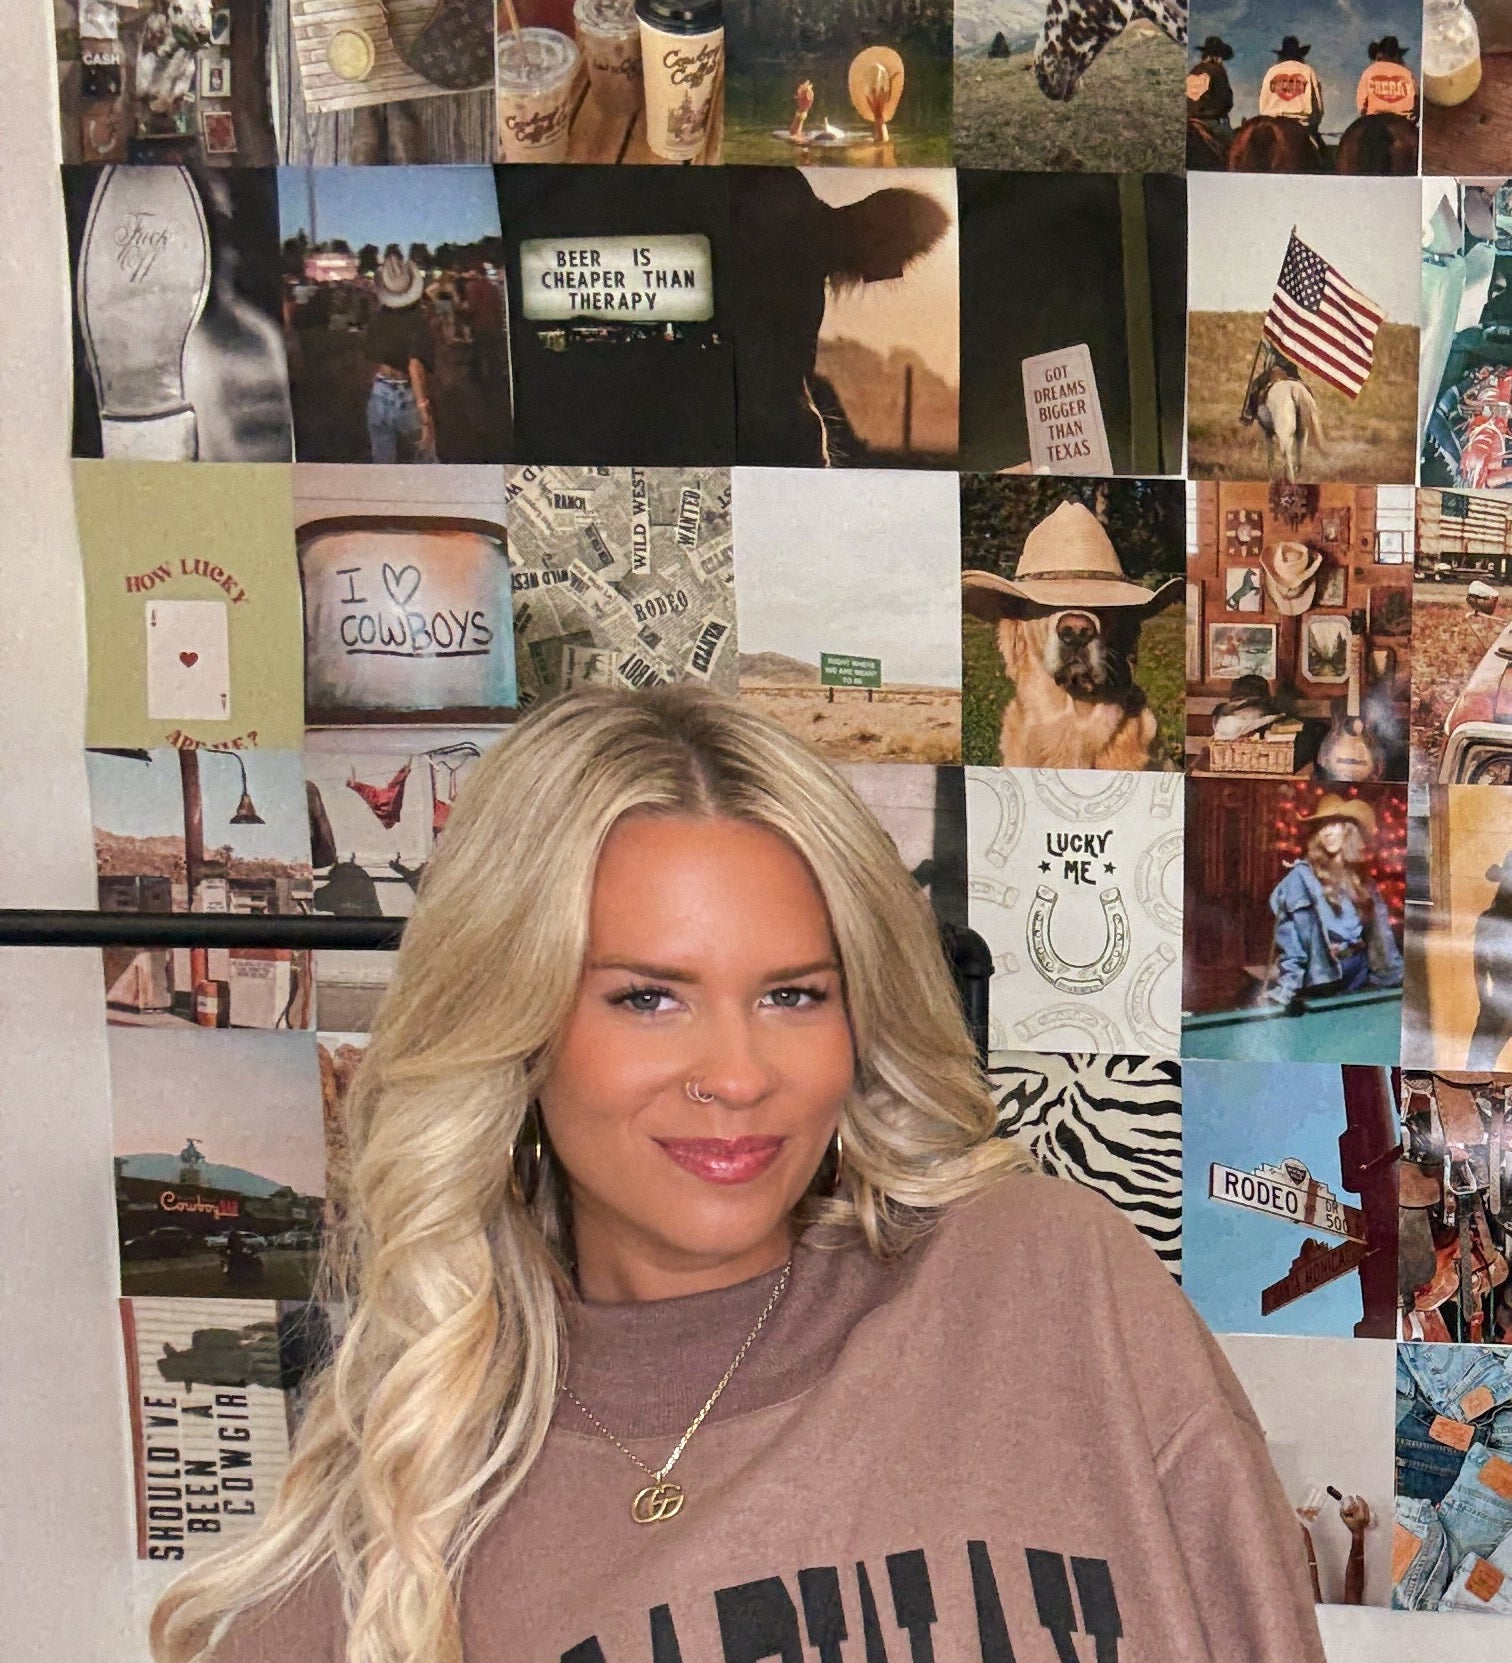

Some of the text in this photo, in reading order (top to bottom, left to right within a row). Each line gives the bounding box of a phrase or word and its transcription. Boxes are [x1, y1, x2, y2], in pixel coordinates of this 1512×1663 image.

[556, 247, 651, 268] BEER IS
[541, 269, 696, 290] CHEAPER THAN
[568, 291, 658, 312] THERAPY
[1044, 363, 1069, 384] GOT
[1033, 379, 1087, 405] DREAMS
[1038, 399, 1087, 423] BIGGER
[1046, 419, 1085, 442] THAN
[1046, 438, 1092, 463] TEXAS
[630, 467, 648, 571] WILD WEST
[677, 489, 702, 548] WANTED
[124, 557, 249, 605] HOW LUCKY
[336, 567, 368, 605] I
[633, 589, 690, 623] RODEO
[340, 609, 495, 653] COWBOYS
[1046, 829, 1114, 858] LUCKY
[1064, 860, 1097, 886] ME
[160, 1190, 219, 1220] Cowboy
[1224, 1170, 1299, 1216] RODEO
[1325, 1199, 1339, 1214] DR
[143, 1395, 185, 1561] SHOULD'VE
[181, 1404, 221, 1533] BEEN A
